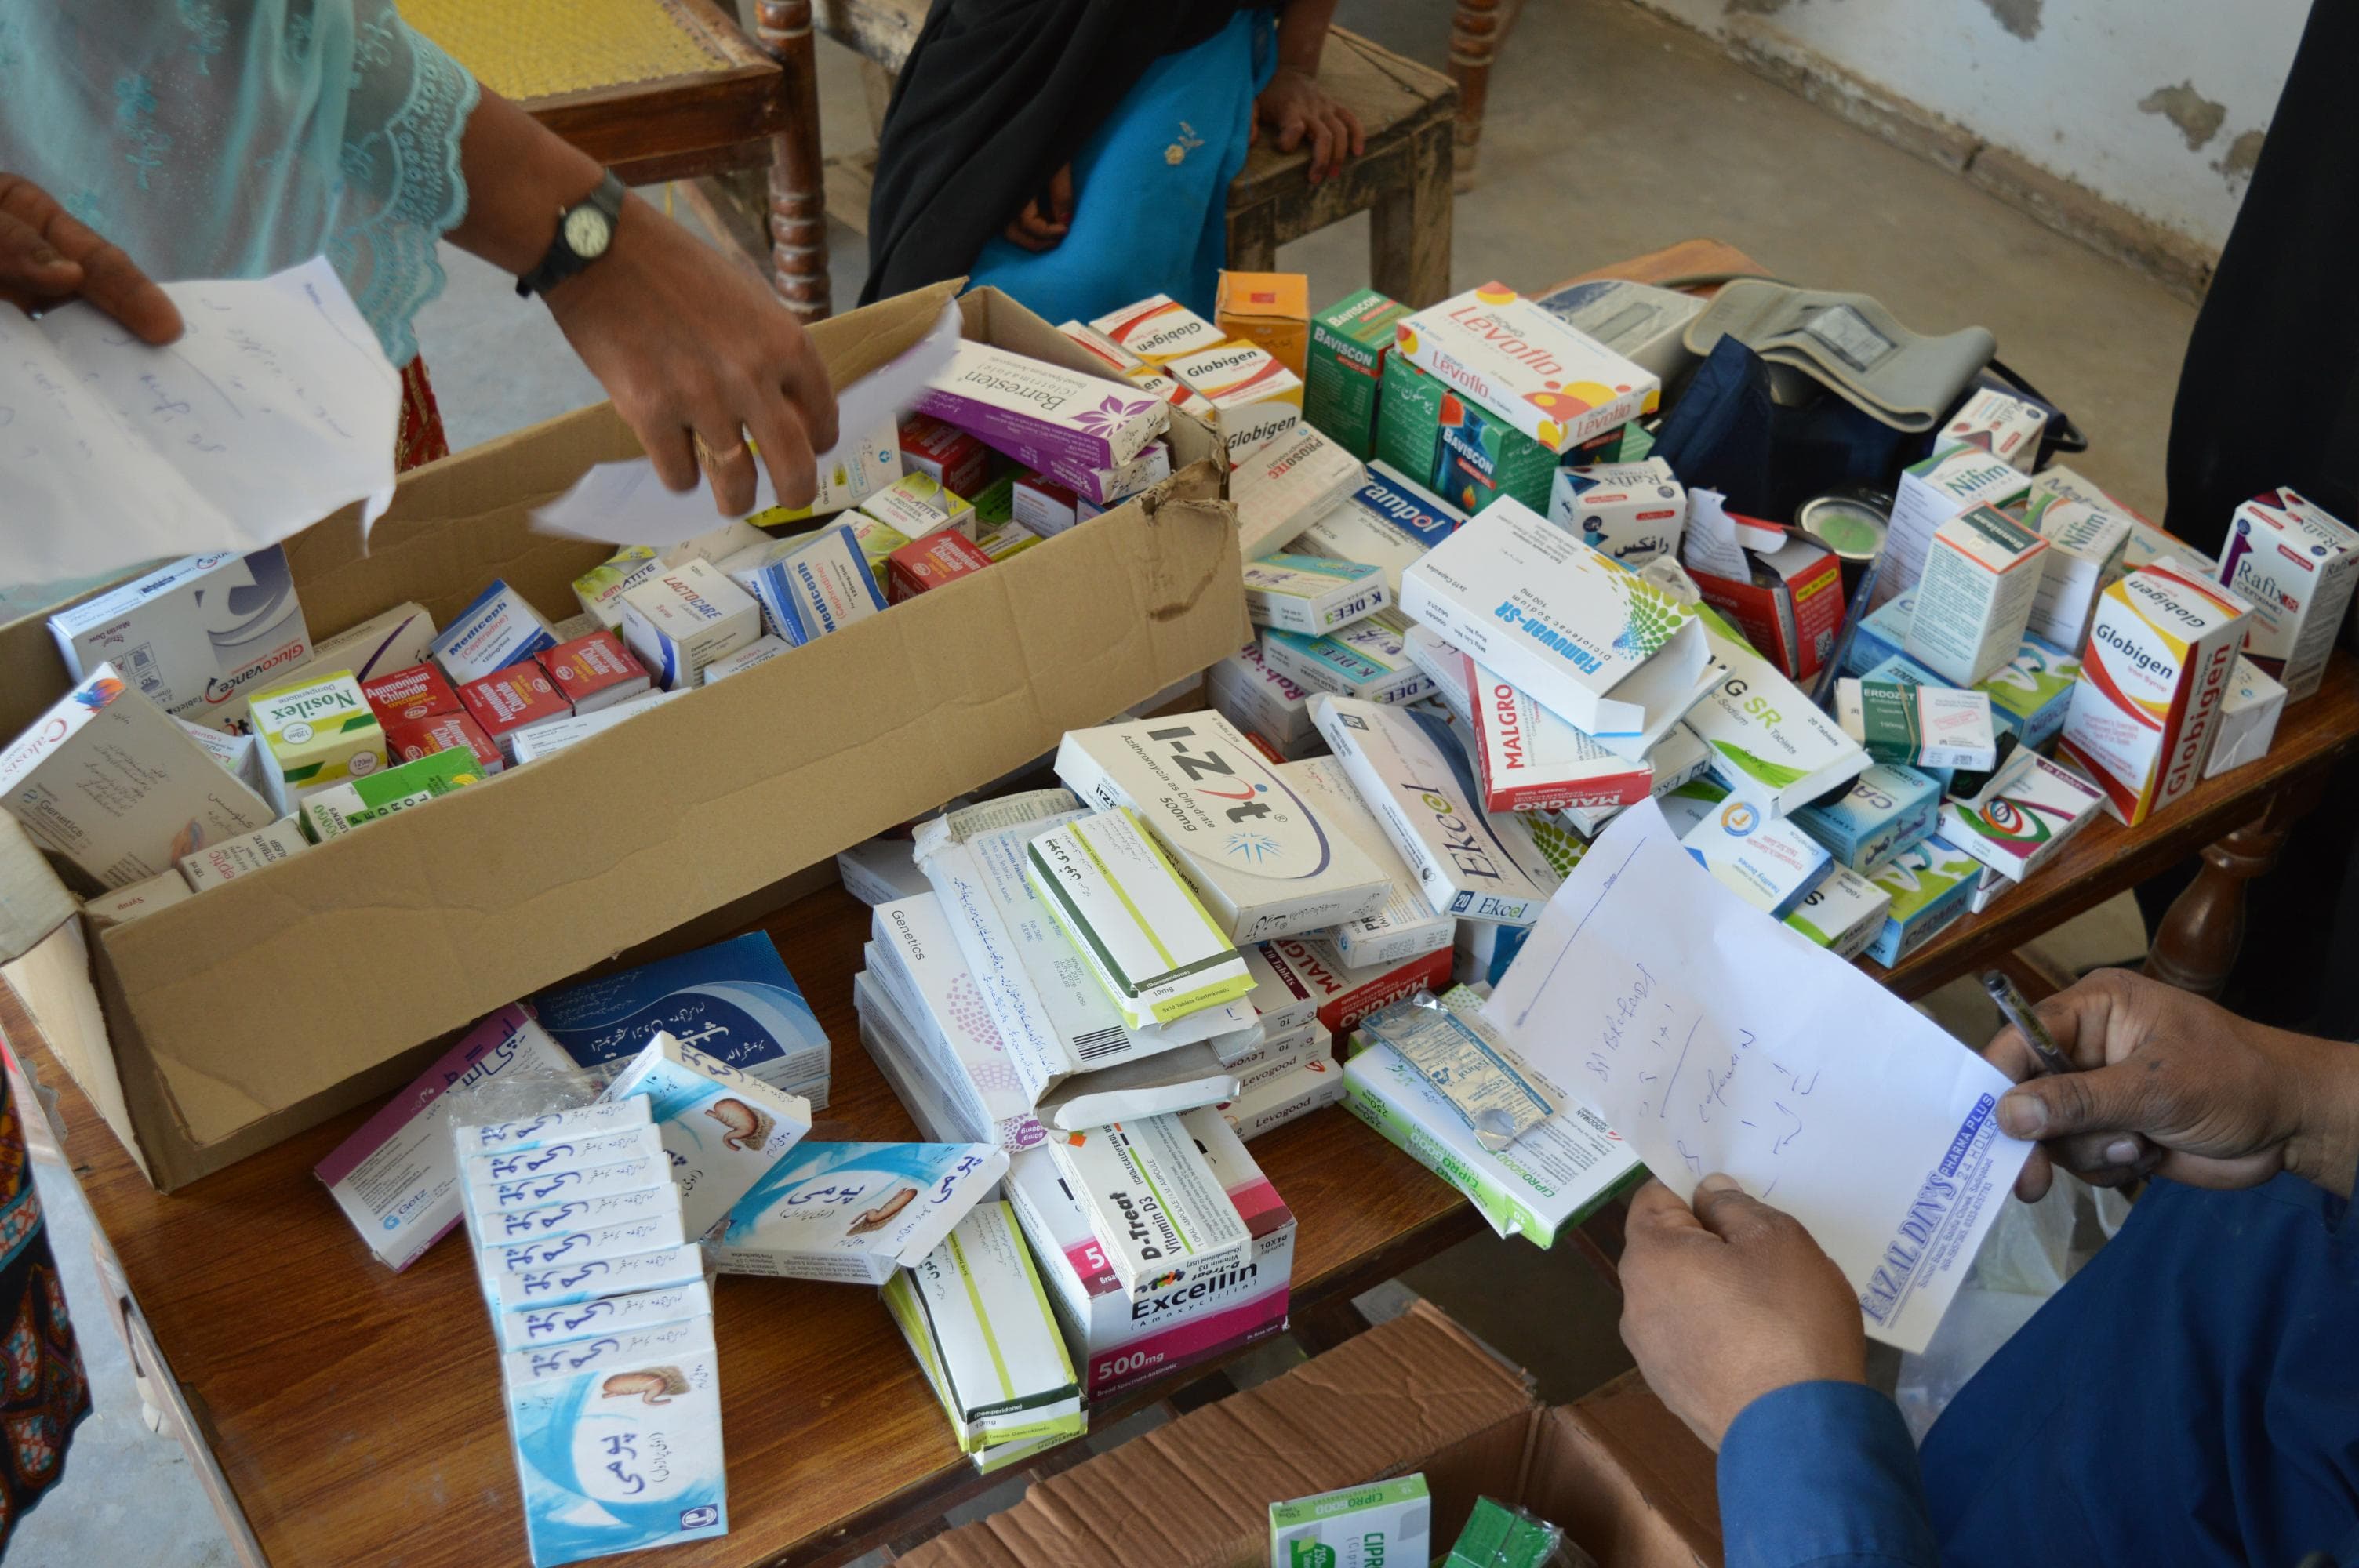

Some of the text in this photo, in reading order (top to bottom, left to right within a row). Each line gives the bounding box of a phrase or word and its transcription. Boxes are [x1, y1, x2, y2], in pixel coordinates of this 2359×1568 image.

[1328, 295, 1382, 328] BAVISCON
[1137, 321, 1201, 354] Globigen
[1314, 325, 1374, 368] BAVISCON
[1448, 306, 1565, 376] Levoflo
[1187, 349, 1258, 378] Globigen
[1432, 350, 1489, 399] Levoflo
[964, 370, 1067, 412] Barresten
[1227, 414, 1296, 451] Globigen
[1576, 402, 1632, 439] Levoflo
[1267, 438, 1324, 480] PROSOTEC
[1442, 426, 1495, 475] BAVISCON
[1945, 464, 2009, 497] Nifim
[2058, 512, 2109, 552] Nifim
[930, 546, 964, 572] Chloride
[937, 536, 982, 571] Ammonium
[663, 576, 723, 620] LACTOCARE
[797, 561, 838, 634] Mediceph
[2237, 560, 2284, 604] Rafix
[1510, 593, 1551, 620] Sodium
[2127, 579, 2207, 629] Globigen
[448, 600, 507, 657] Mediceph
[461, 614, 510, 660] (Cephradine)
[1493, 600, 1605, 677] Flamowan-SR
[219, 643, 305, 694] Glucovance
[578, 647, 611, 676] Chloride
[589, 638, 629, 674] Ammonium
[2095, 623, 2174, 681] Globigen
[365, 672, 431, 699] Ammonium
[380, 683, 429, 704] Chloride
[477, 683, 517, 724] Ammonium
[496, 681, 527, 713] Chloride
[1863, 688, 1916, 701] ERDOZT
[271, 688, 357, 721] Nosilex
[1717, 696, 1750, 727] Sodium
[2166, 642, 2231, 797] Globigen
[1216, 720, 1241, 744] TABLETS
[1493, 684, 1525, 771] MALGRO
[1743, 695, 1783, 730] SR
[1769, 727, 1798, 756] Tablets
[1816, 723, 1840, 747] Tablets
[1121, 733, 1171, 782] Azithromycin
[1176, 789, 1216, 829] Dihydrate
[39, 799, 85, 839] Genetics
[1158, 796, 1198, 833] 500mg
[1512, 793, 1621, 811] MALGRO
[1401, 782, 1504, 884] Ekcol
[1455, 893, 1528, 920] 20 Ekcol
[891, 908, 926, 962] Genetics
[1147, 970, 1190, 989] (Domperidone)
[1270, 954, 1296, 986] Tablets
[1278, 939, 1344, 996] MALGR
[1152, 985, 1175, 997] 10mg
[1176, 996, 1195, 1010] Tablets
[1194, 986, 1230, 1004] Gastrokinetic
[1241, 1055, 1298, 1089] Levogood
[1256, 1096, 1311, 1129] Levogood
[1940, 1094, 1996, 1177] PHARMA PLUS
[1956, 1110, 1998, 1181] 24 HOUR
[1109, 1131, 1143, 1185] (CHOLECALCIFEROL
[1409, 1132, 1480, 1188] CIPROGOOD
[1496, 1149, 1557, 1198] CIPROGOOD
[398, 1189, 427, 1215] Getz
[787, 1184, 866, 1206] پومی
[1109, 1191, 1164, 1261] D-Treat
[1138, 1195, 1183, 1255] Vitamin D3
[1259, 1233, 1289, 1250] 10X10
[1191, 1260, 1241, 1282] D-Treat
[1210, 1254, 1240, 1269] Vitamin
[1130, 1278, 1258, 1330] (Amoxycillin)
[1131, 1261, 1259, 1321] Excellin
[1097, 1350, 1165, 1381] 500mg
[973, 1403, 1023, 1419] (Domperidone)
